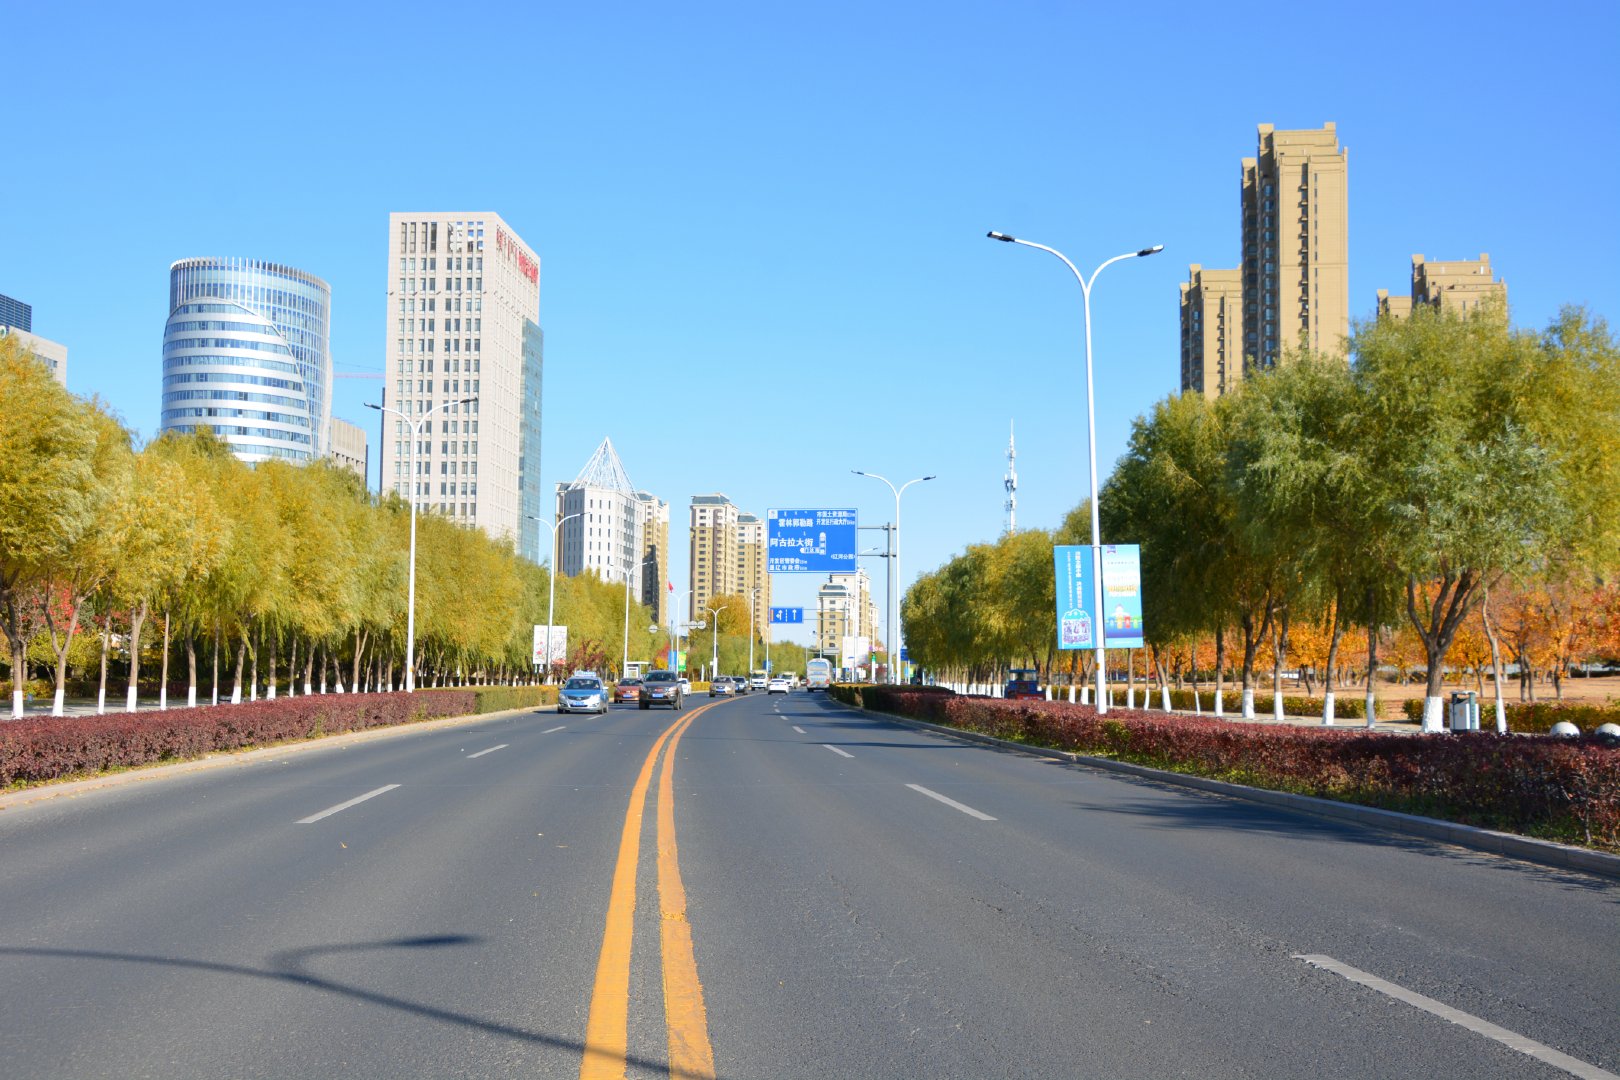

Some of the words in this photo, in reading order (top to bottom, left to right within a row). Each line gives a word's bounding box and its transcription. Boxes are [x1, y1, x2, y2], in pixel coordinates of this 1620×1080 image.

[770, 538, 814, 547] 阿古拉大街
